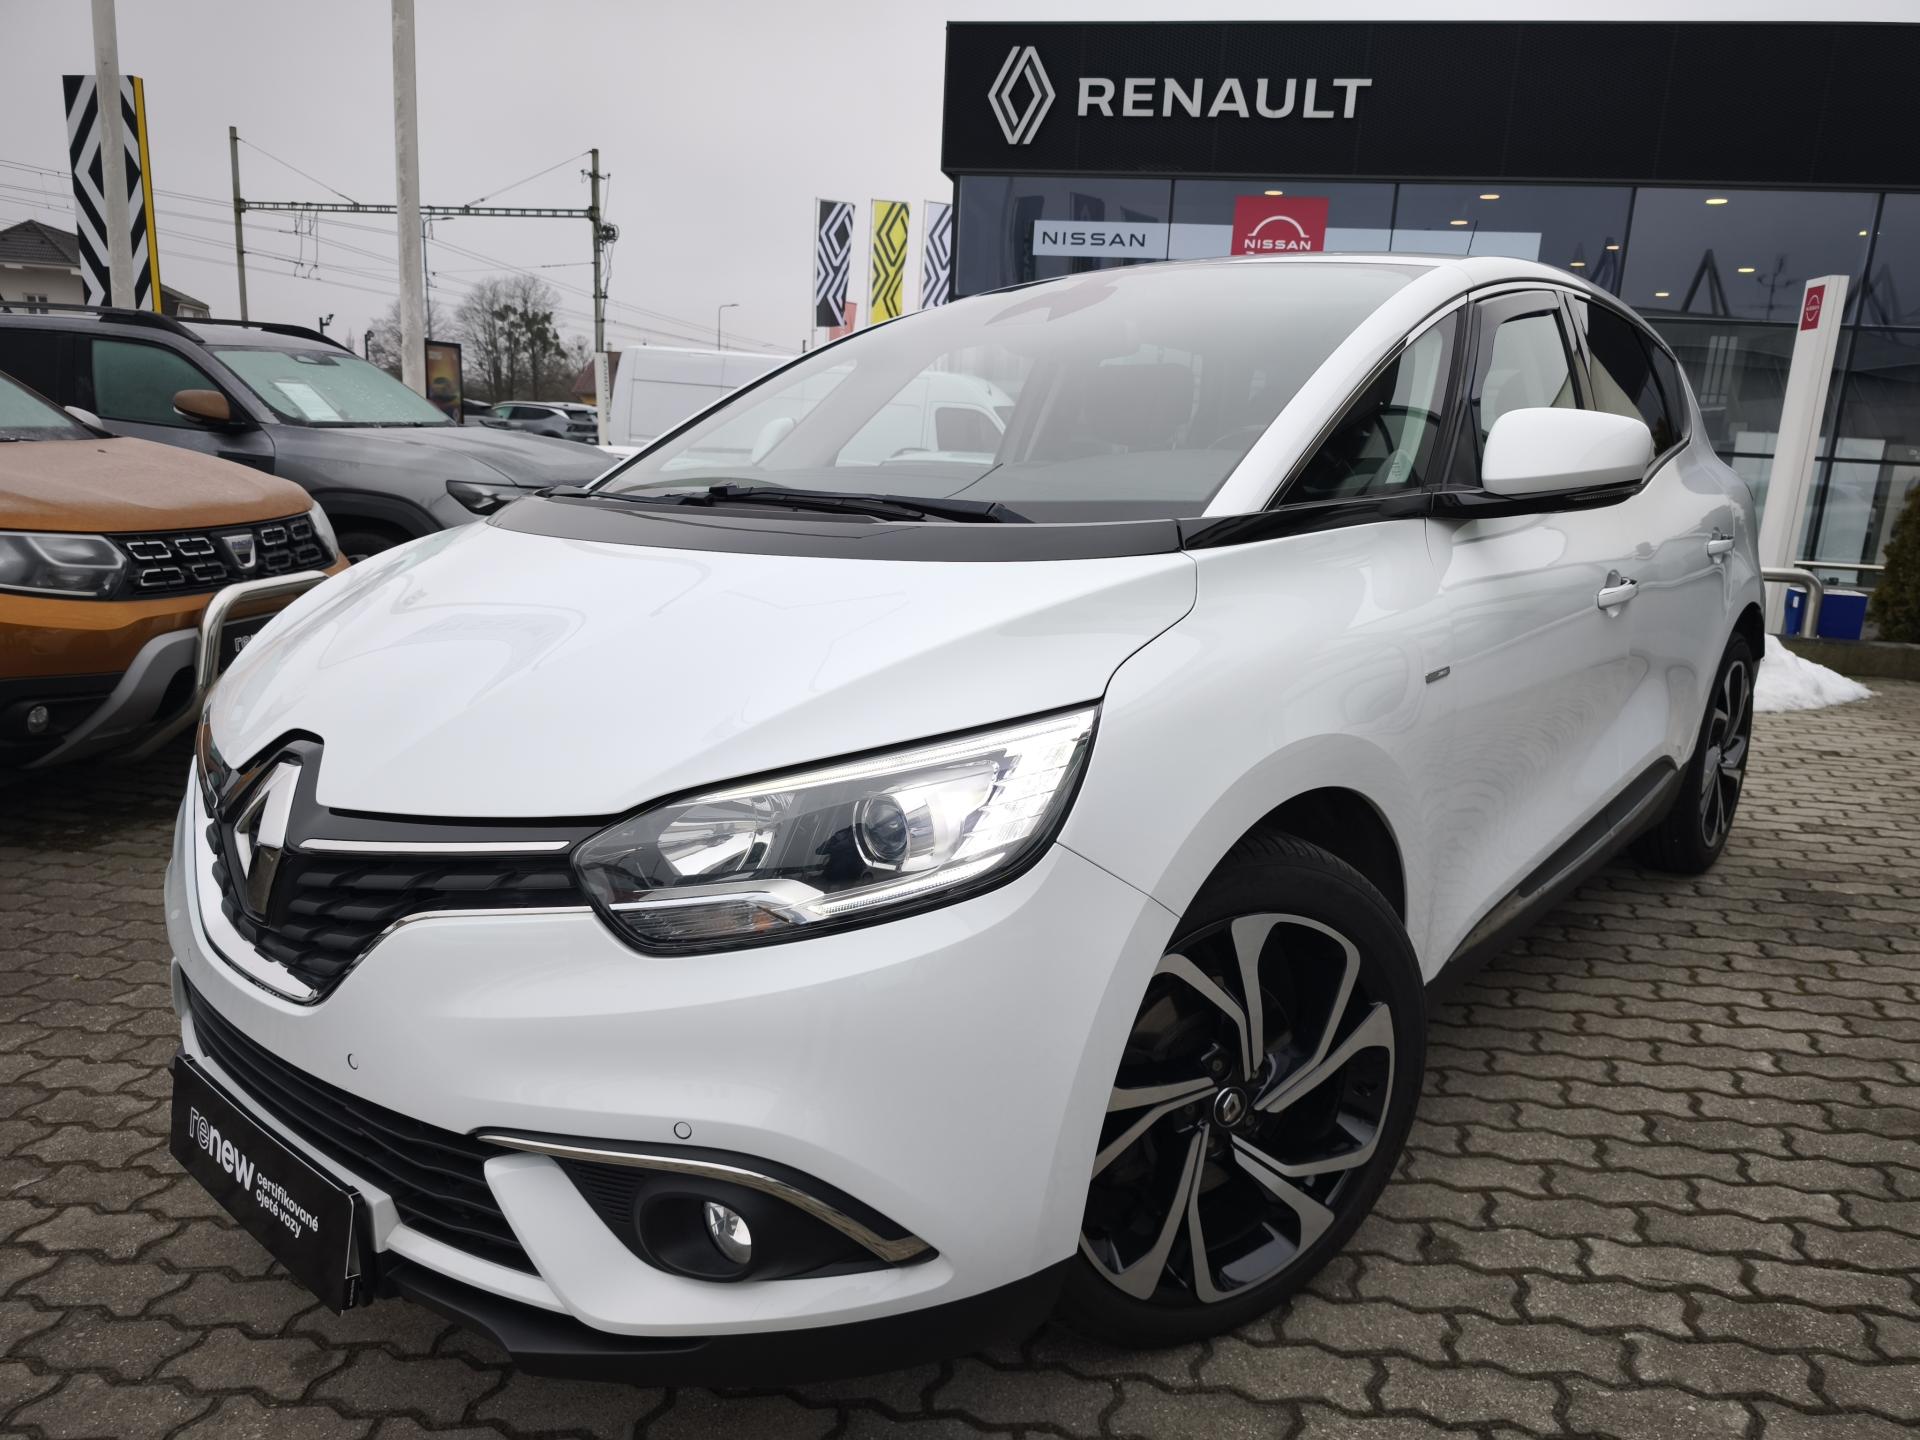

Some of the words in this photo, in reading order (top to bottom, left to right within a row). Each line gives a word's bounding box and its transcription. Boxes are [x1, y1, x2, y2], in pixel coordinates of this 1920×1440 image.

[1077, 77, 1373, 119] RENAULT
[1041, 231, 1146, 248] NISSAN
[1243, 238, 1312, 251] NISSAN
[189, 1106, 255, 1191] renew
[256, 1189, 279, 1217] ojeté
[279, 1208, 302, 1239] vozy
[257, 1172, 319, 1232] certifikované
